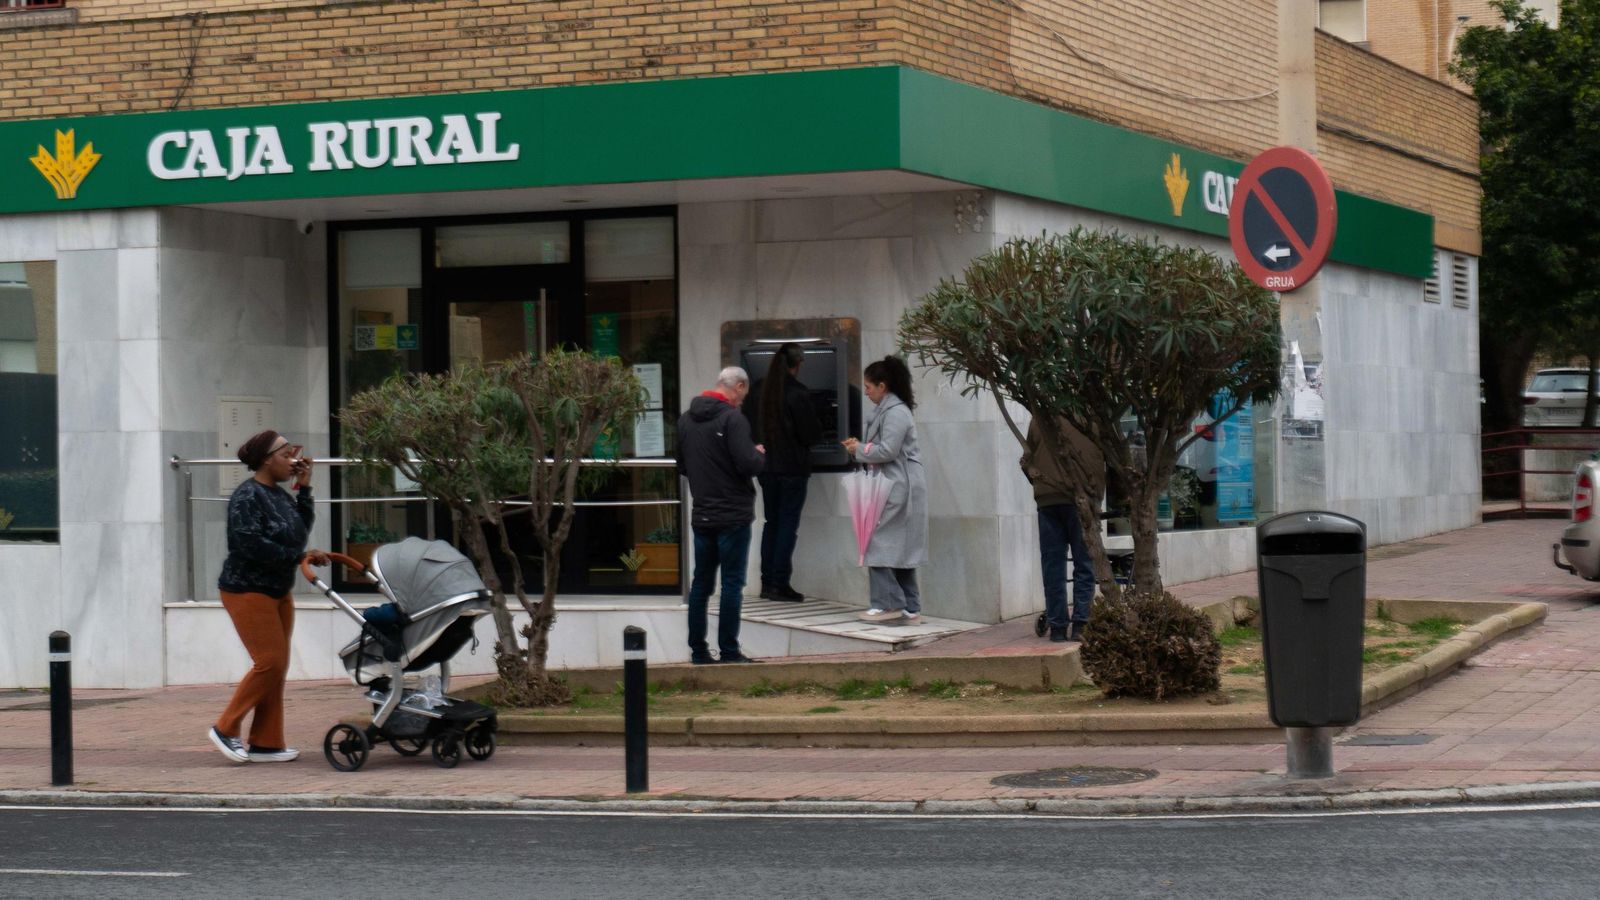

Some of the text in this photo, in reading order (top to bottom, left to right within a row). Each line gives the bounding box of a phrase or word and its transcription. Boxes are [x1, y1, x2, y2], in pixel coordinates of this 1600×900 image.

[147, 112, 520, 181] CAJA RURAL
[1203, 170, 1239, 216] CAJ
[1265, 276, 1296, 288] GRUA
